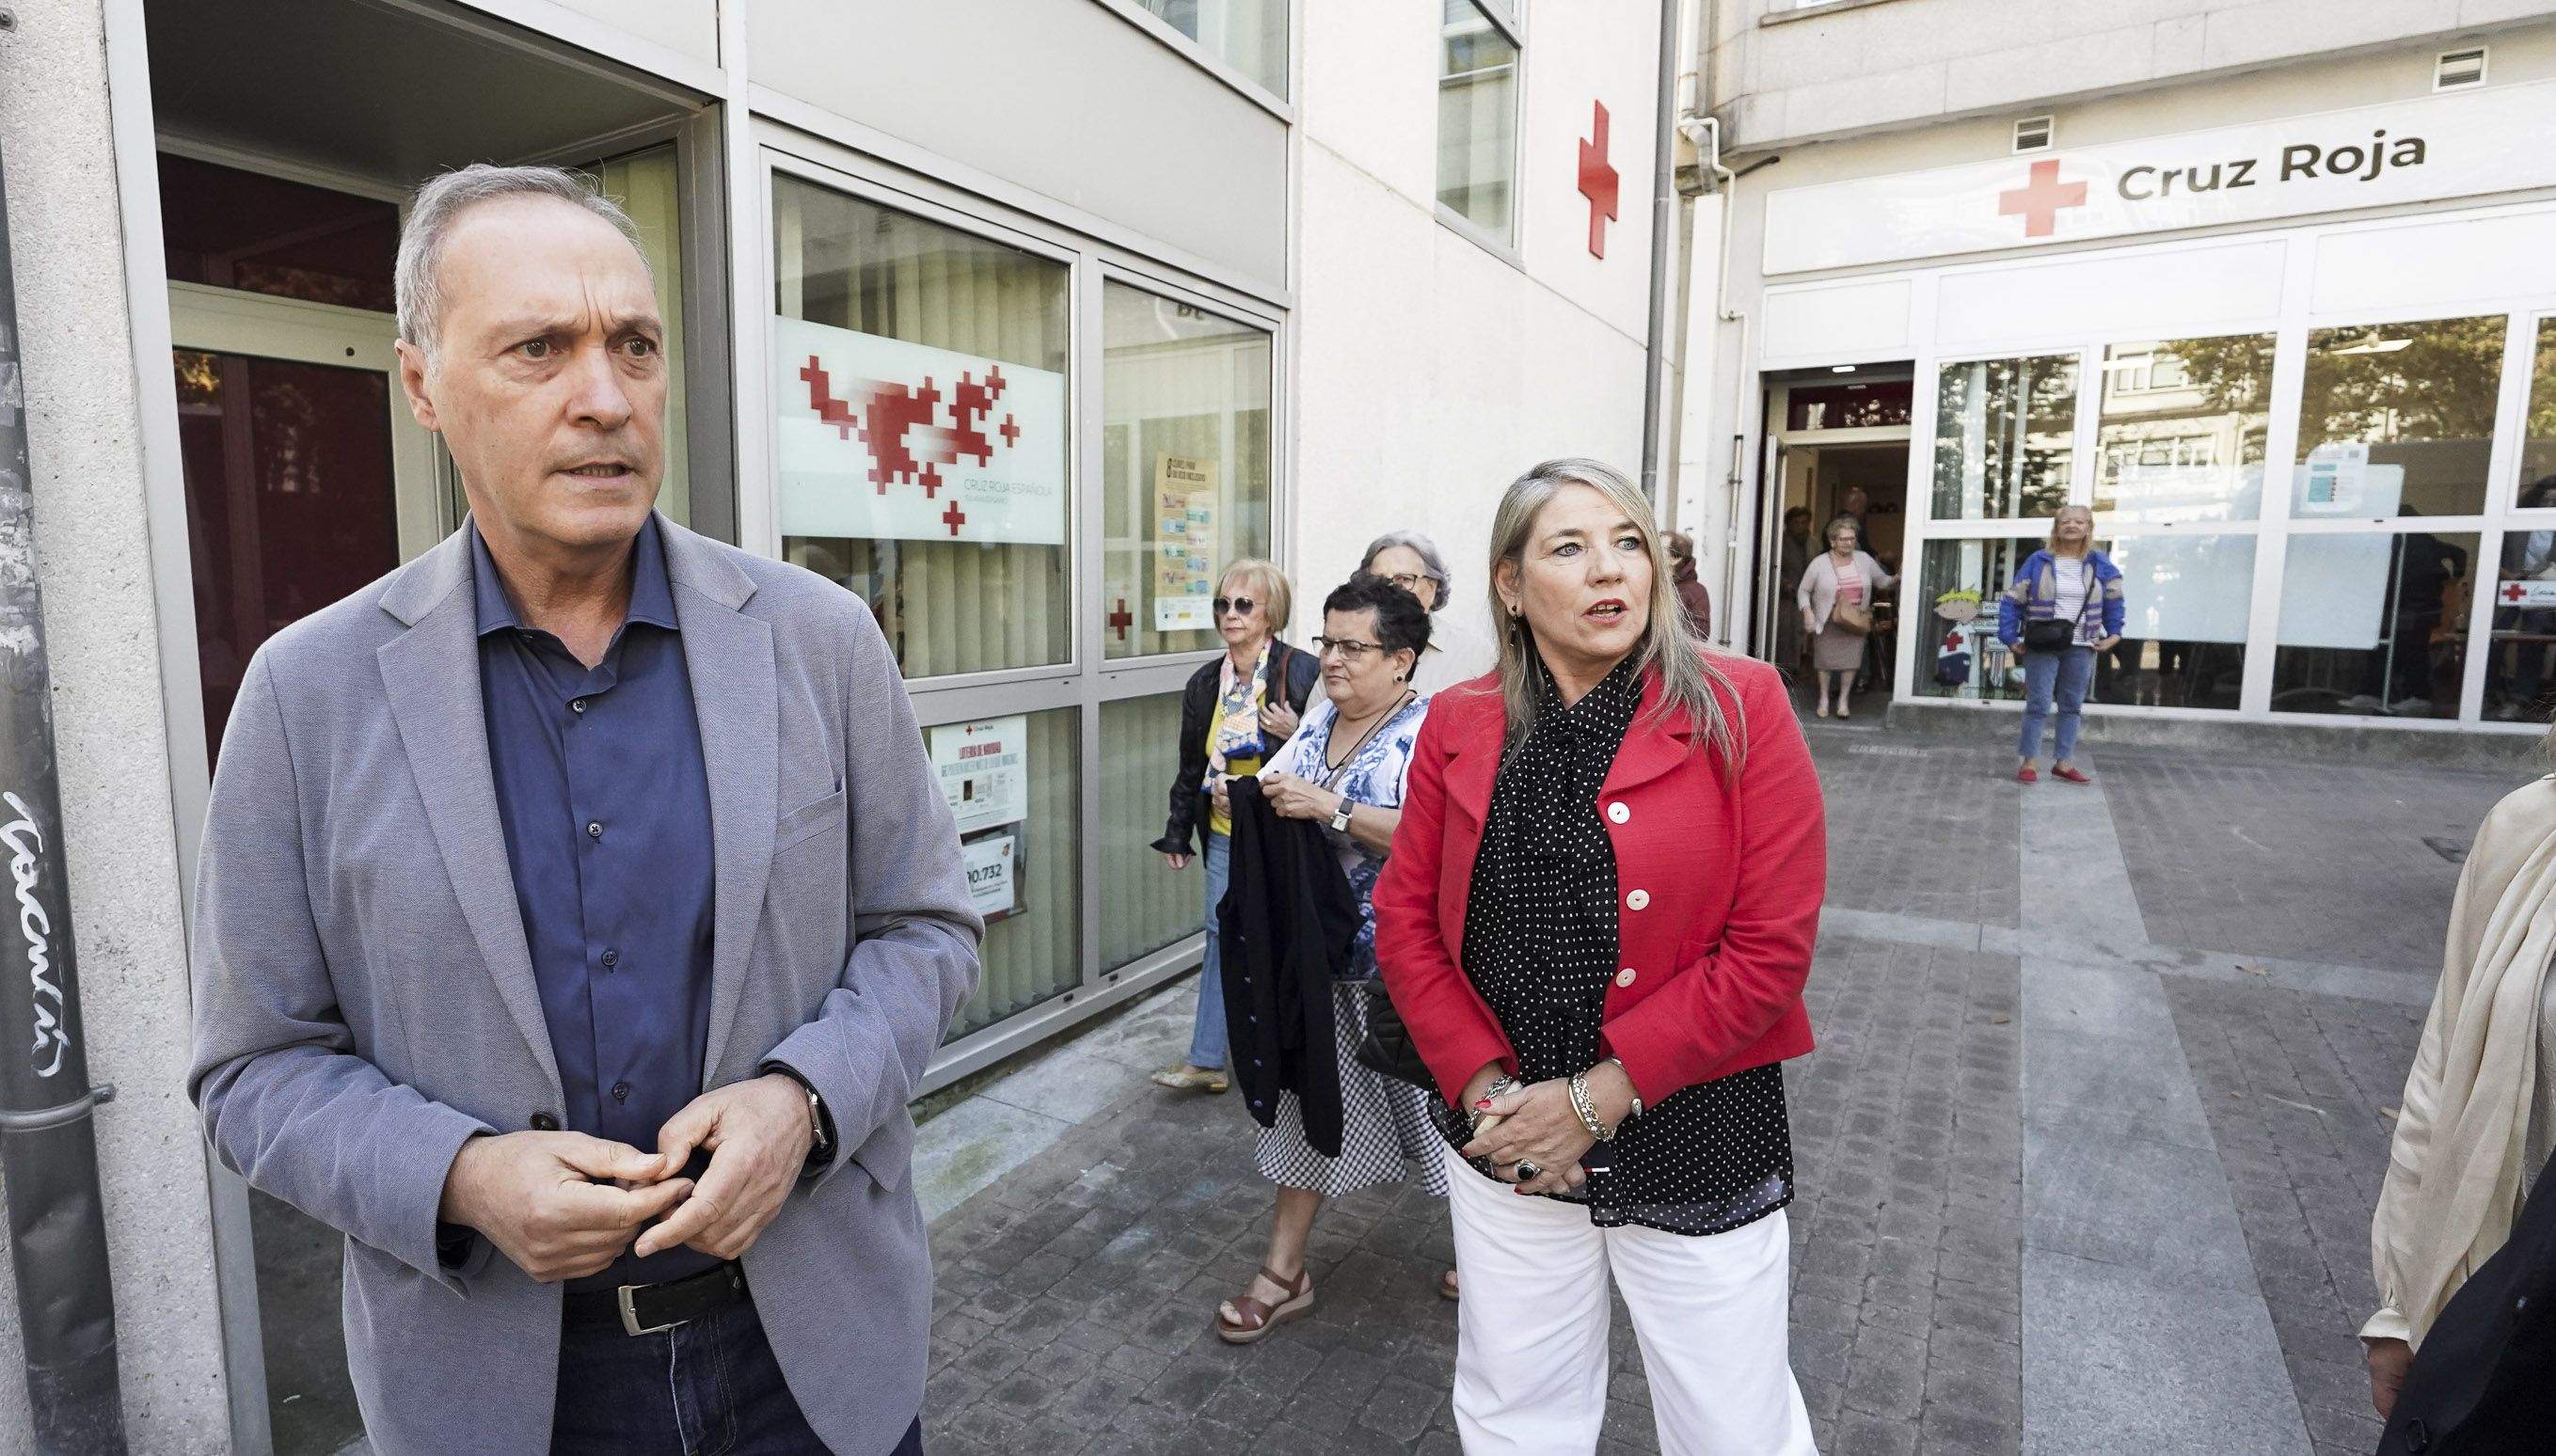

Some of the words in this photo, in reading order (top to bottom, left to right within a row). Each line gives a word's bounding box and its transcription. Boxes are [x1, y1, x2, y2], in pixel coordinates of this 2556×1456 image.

[2118, 158, 2258, 201] Cruz
[2280, 129, 2426, 182] Roja
[963, 478, 988, 492] CRUZ
